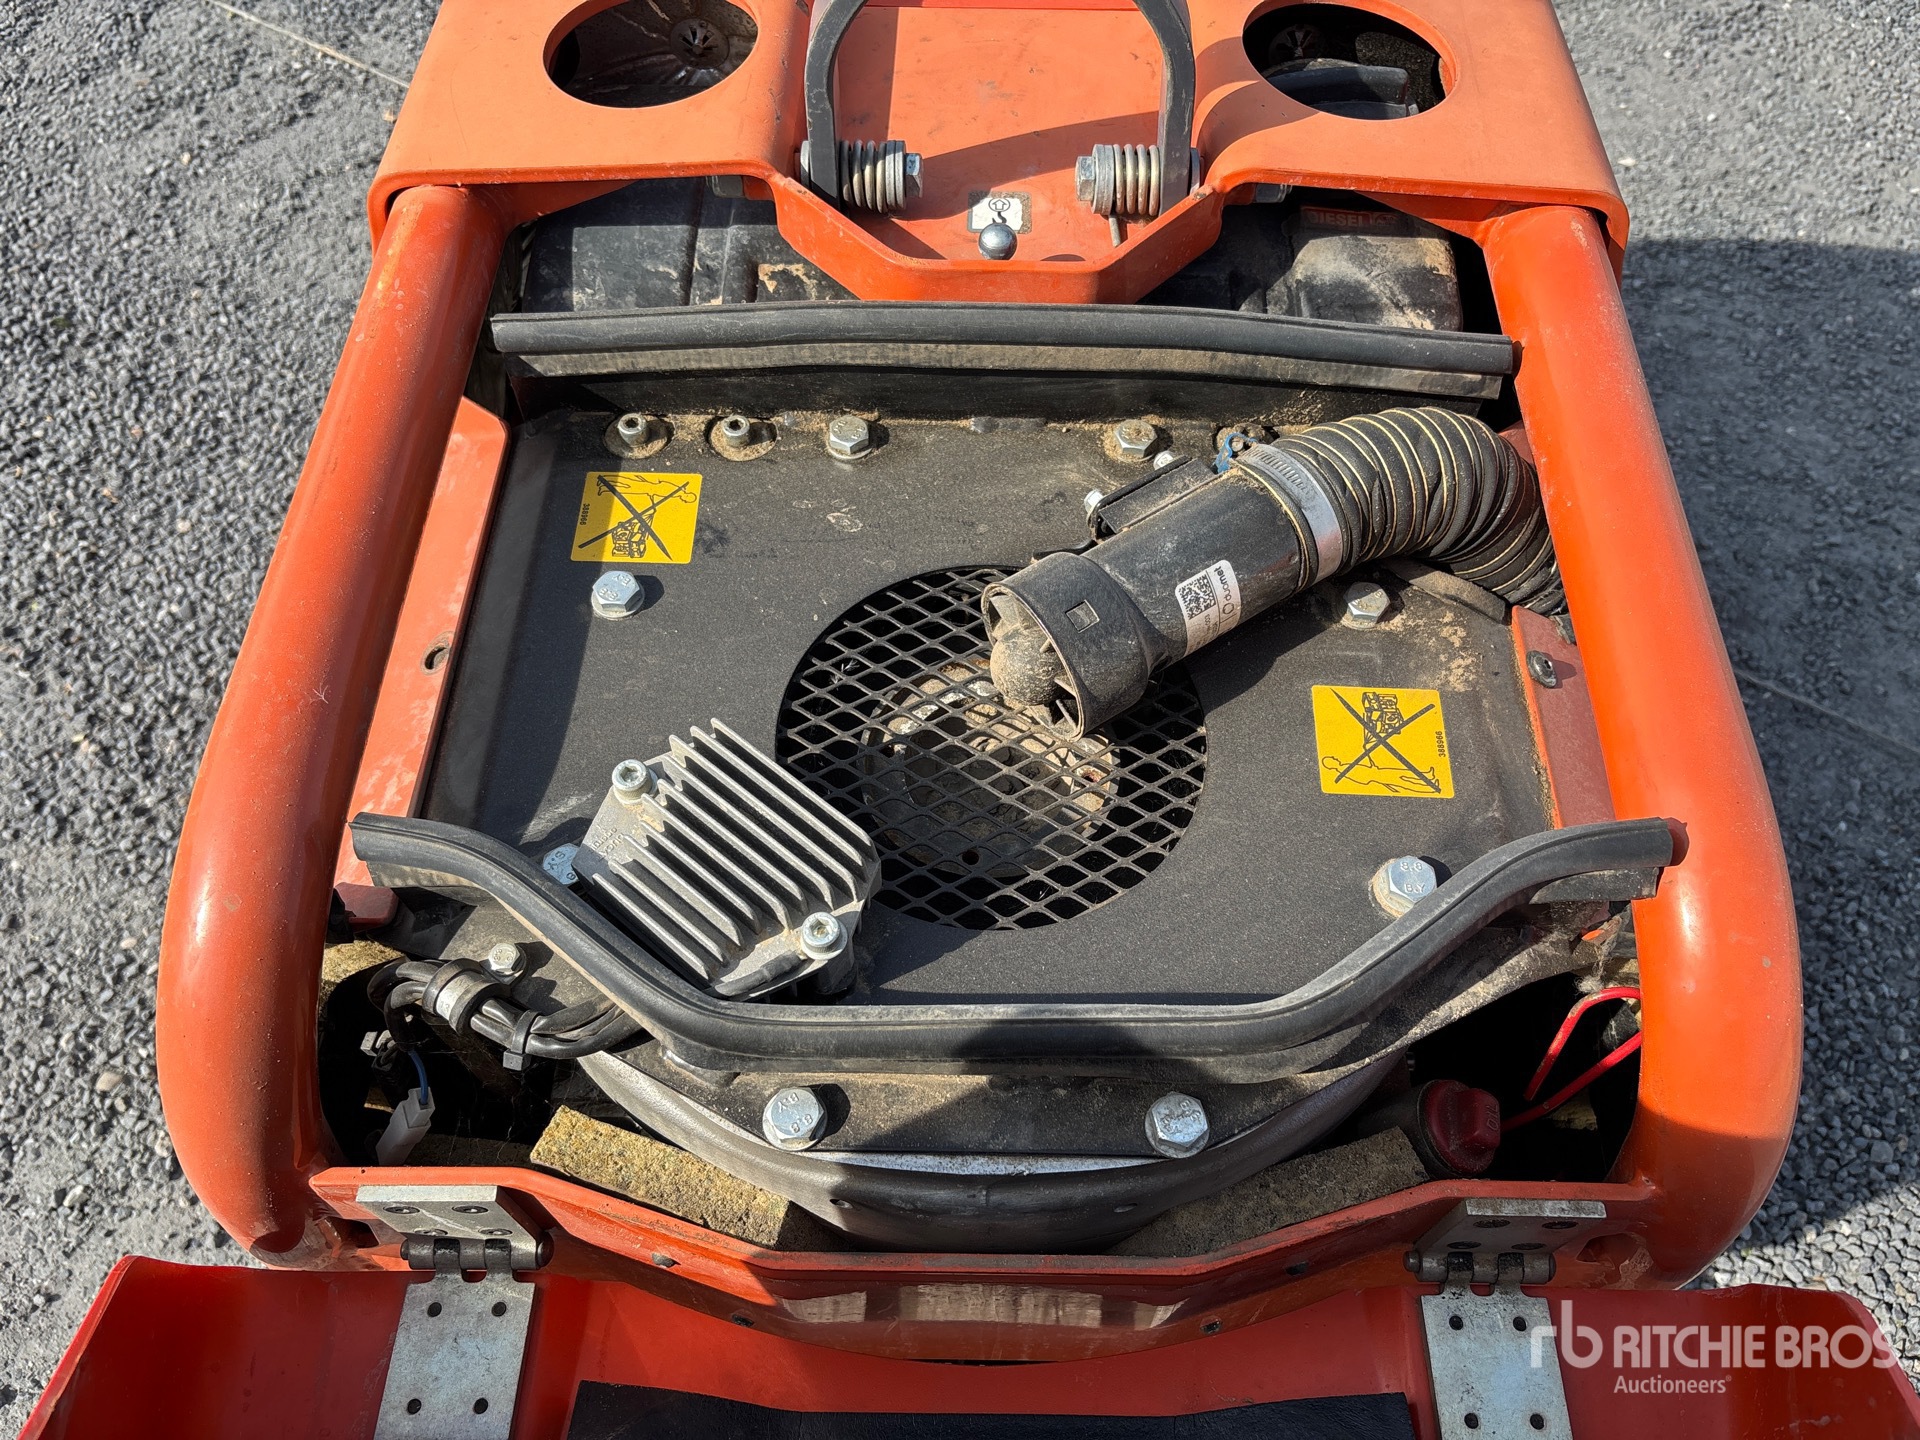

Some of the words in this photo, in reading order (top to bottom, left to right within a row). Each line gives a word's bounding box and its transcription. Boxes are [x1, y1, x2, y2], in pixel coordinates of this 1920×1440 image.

[1306, 210, 1365, 227] DIESEL
[1213, 565, 1232, 602] duomet
[1435, 730, 1447, 758] 388966
[1400, 861, 1423, 872] 8.8
[1404, 883, 1426, 894] B.Y
[777, 1091, 800, 1113] B.Y
[789, 1113, 814, 1134] 8.8
